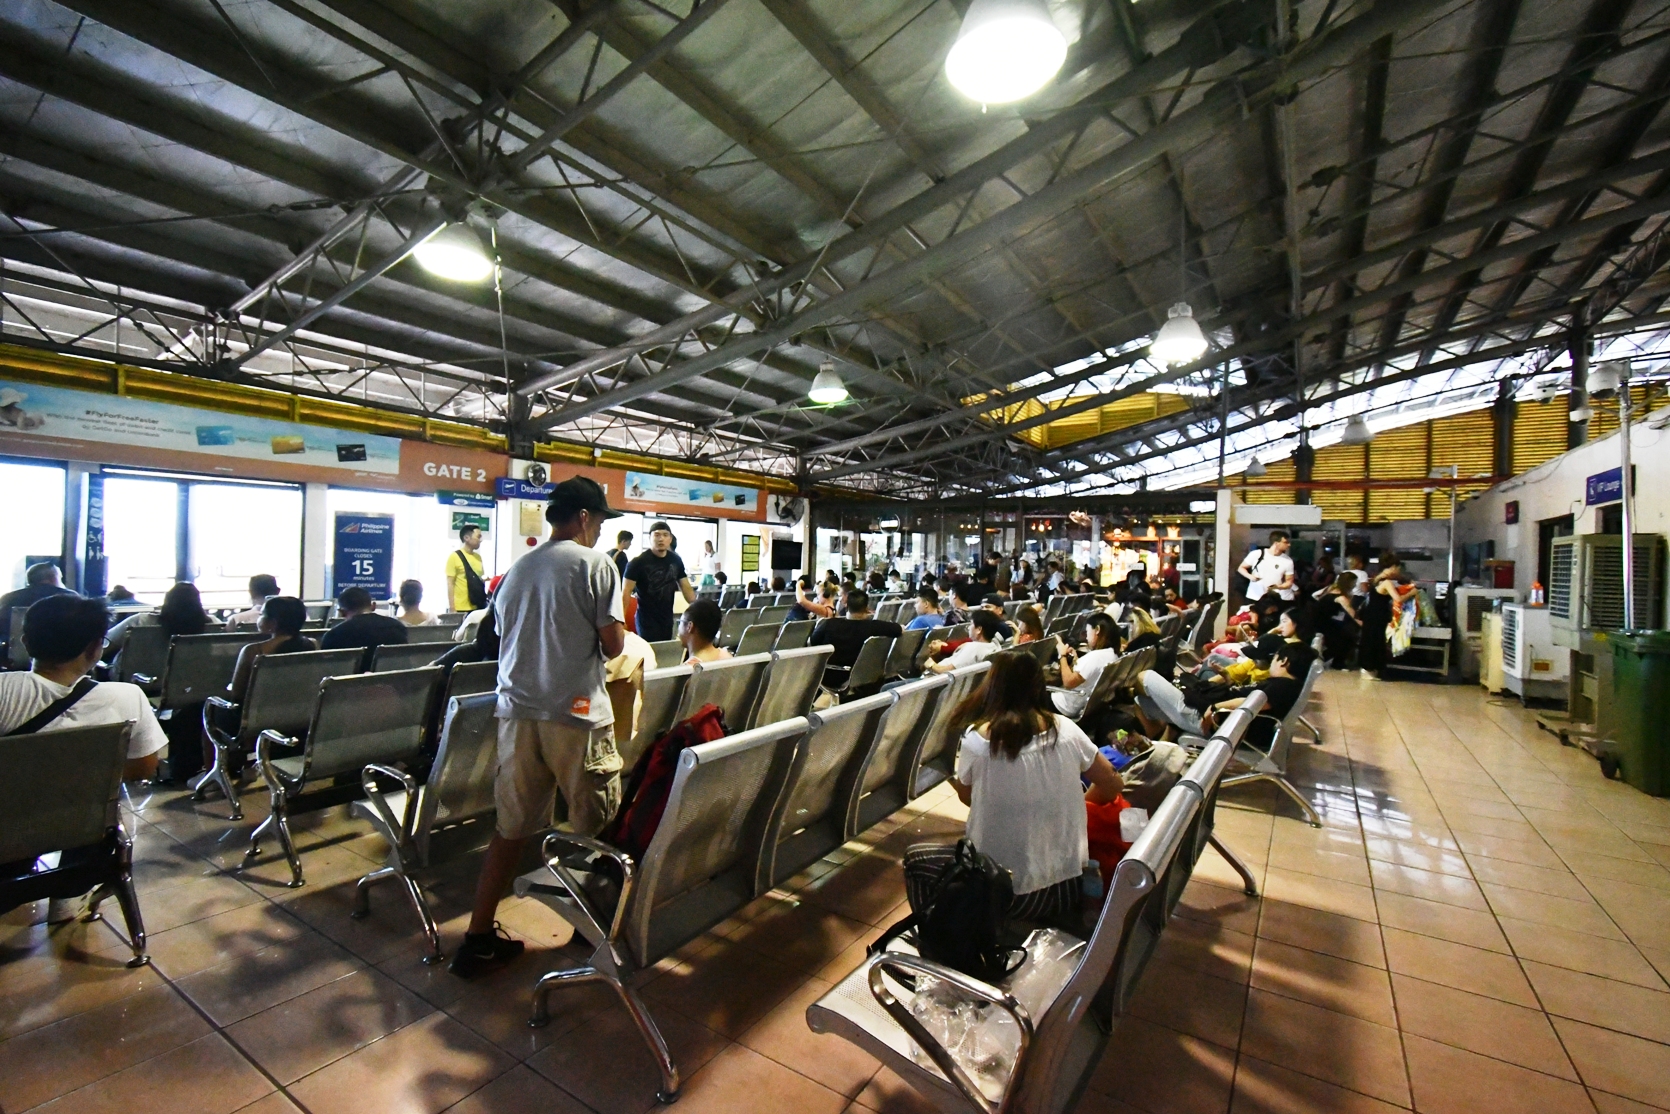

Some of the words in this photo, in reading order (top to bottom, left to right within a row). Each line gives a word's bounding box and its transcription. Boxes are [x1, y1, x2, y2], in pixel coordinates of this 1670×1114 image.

[423, 462, 472, 480] GATE
[476, 469, 487, 482] 2
[351, 560, 374, 575] 15
